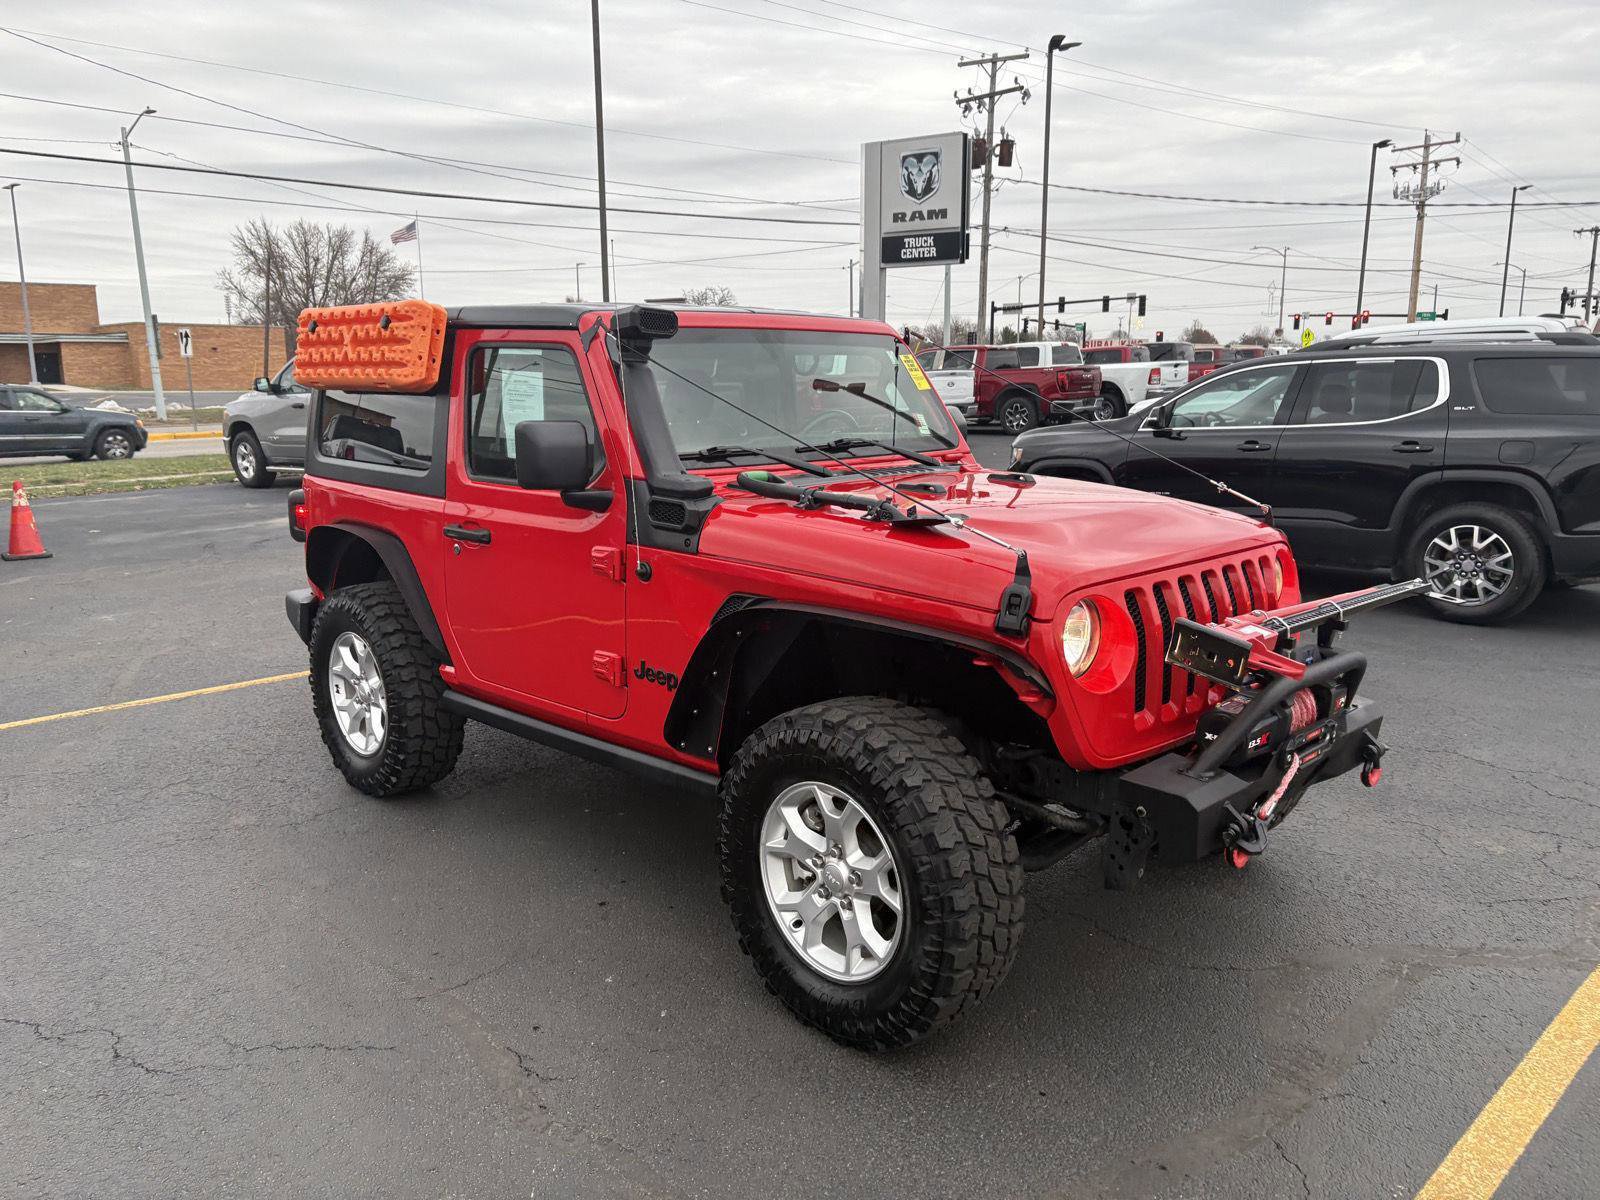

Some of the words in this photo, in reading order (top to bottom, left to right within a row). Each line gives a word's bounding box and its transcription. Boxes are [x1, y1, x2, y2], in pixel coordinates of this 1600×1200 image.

[893, 208, 947, 223] RAM
[904, 236, 934, 248] TRUCK
[901, 247, 937, 259] CENTER
[633, 659, 678, 691] Jeep
